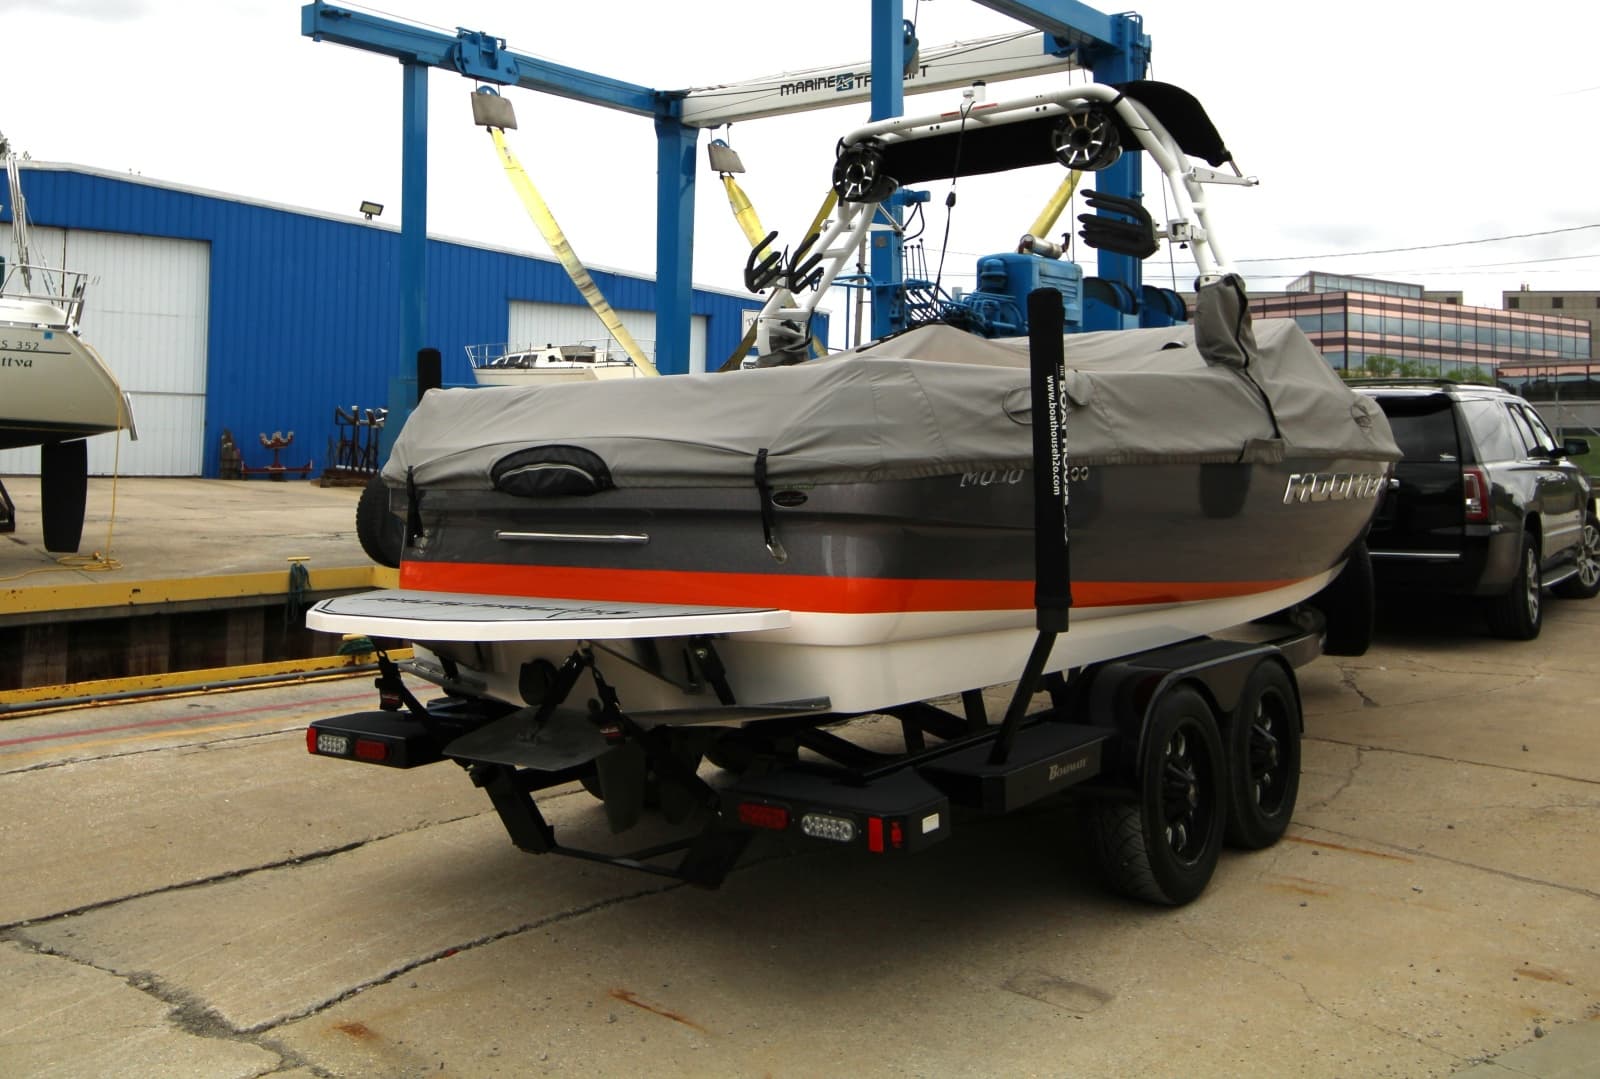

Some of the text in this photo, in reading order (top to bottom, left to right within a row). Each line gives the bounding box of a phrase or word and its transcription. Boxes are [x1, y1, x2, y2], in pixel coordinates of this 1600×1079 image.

[780, 75, 836, 96] MARINE
[16, 341, 39, 351] 352
[1046, 375, 1061, 496] www.boathouseh2o.com
